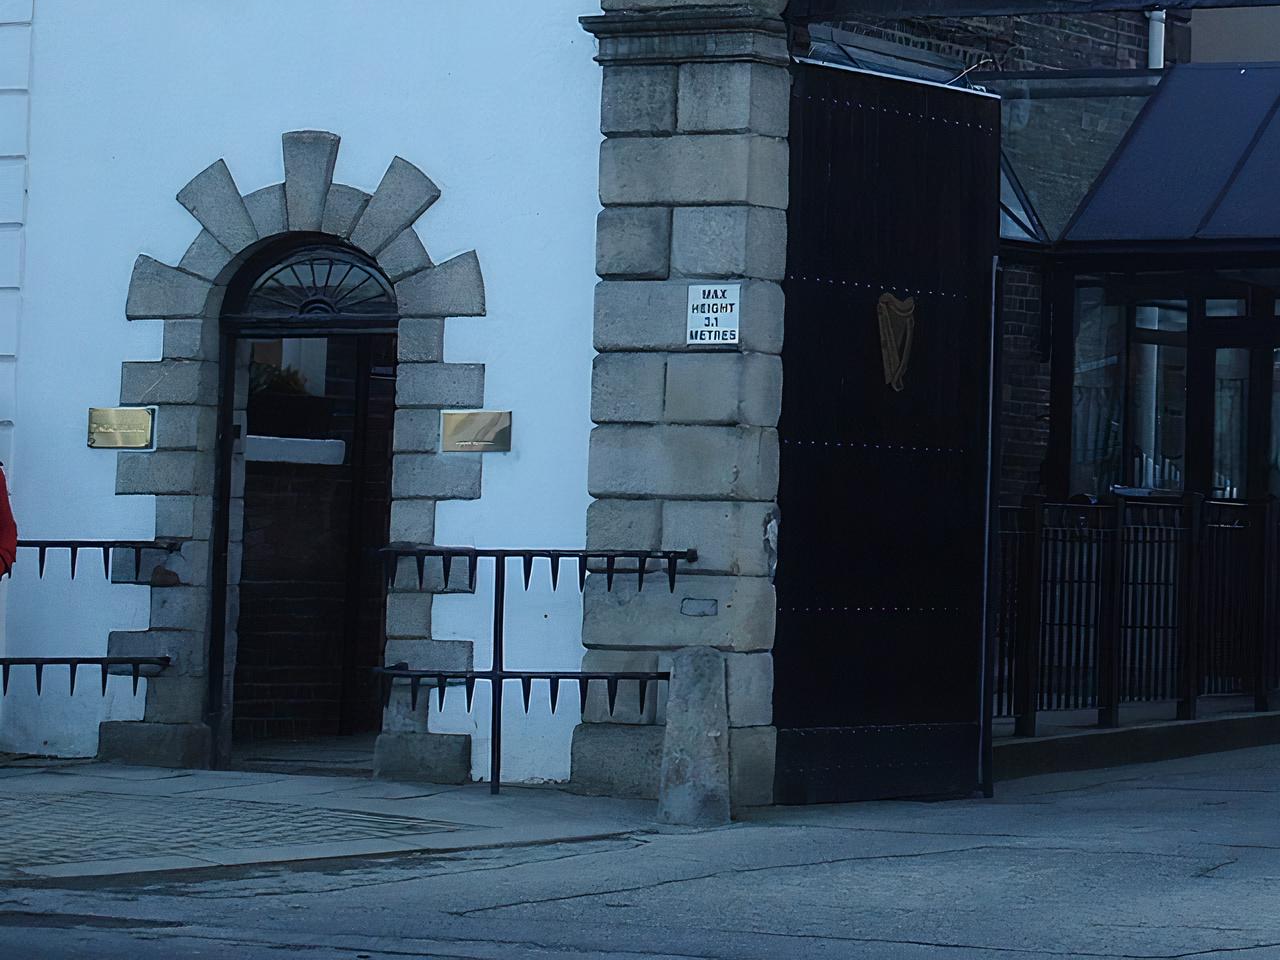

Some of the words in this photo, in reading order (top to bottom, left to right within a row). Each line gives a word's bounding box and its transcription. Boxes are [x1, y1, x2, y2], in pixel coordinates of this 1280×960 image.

[702, 289, 727, 299] MAX
[691, 303, 735, 313] HEIGHT
[704, 316, 719, 327] 3.1
[689, 329, 736, 341] METRES
